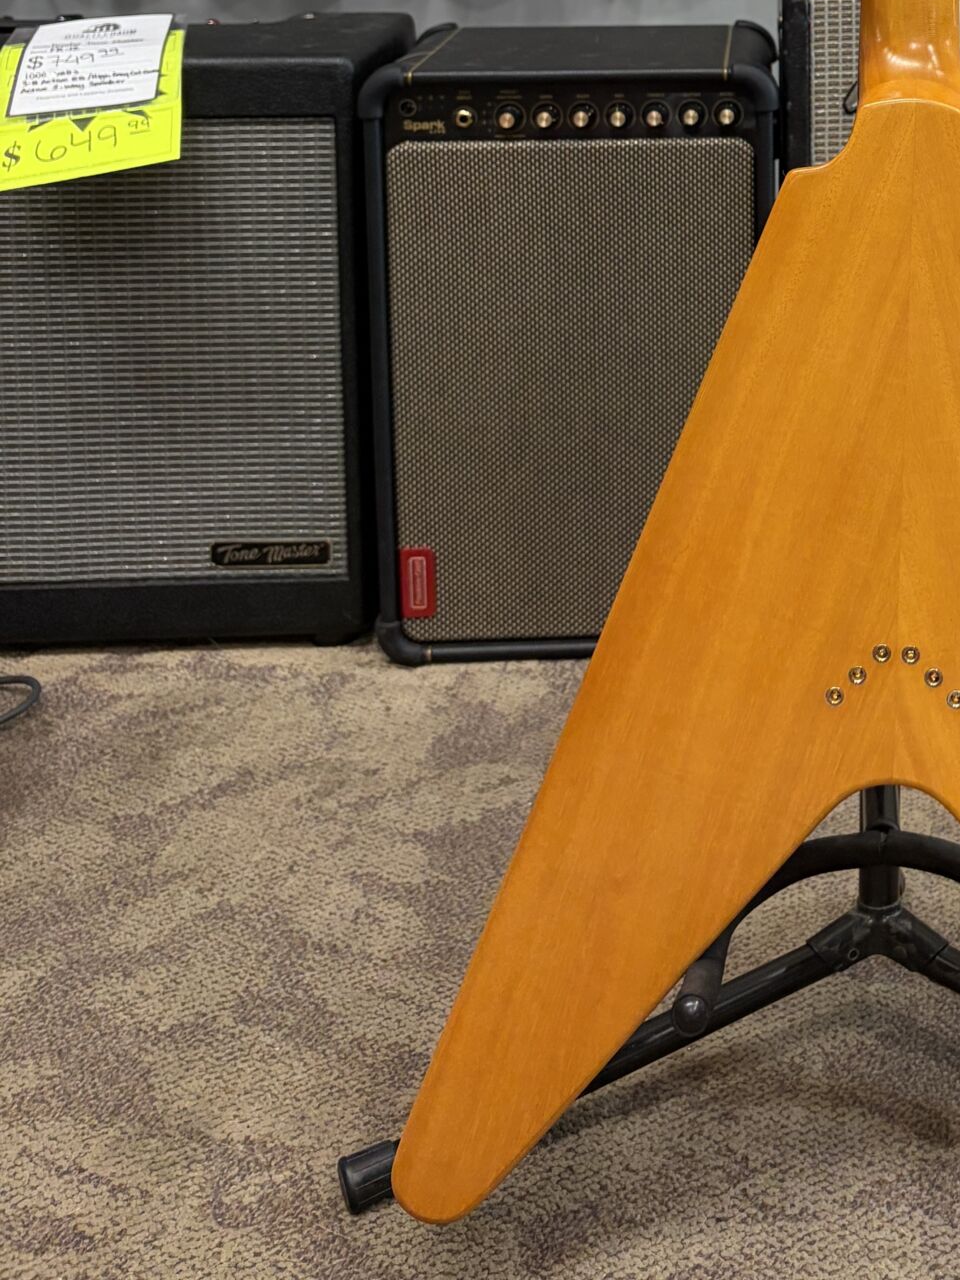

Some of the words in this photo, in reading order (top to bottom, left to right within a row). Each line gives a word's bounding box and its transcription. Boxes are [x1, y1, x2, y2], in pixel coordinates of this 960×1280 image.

[27, 53, 96, 70] $749
[403, 119, 446, 132] Spark
[2, 125, 118, 172] $649
[127, 118, 152, 132] 99
[217, 544, 259, 564] Tone
[263, 543, 321, 563] Master
